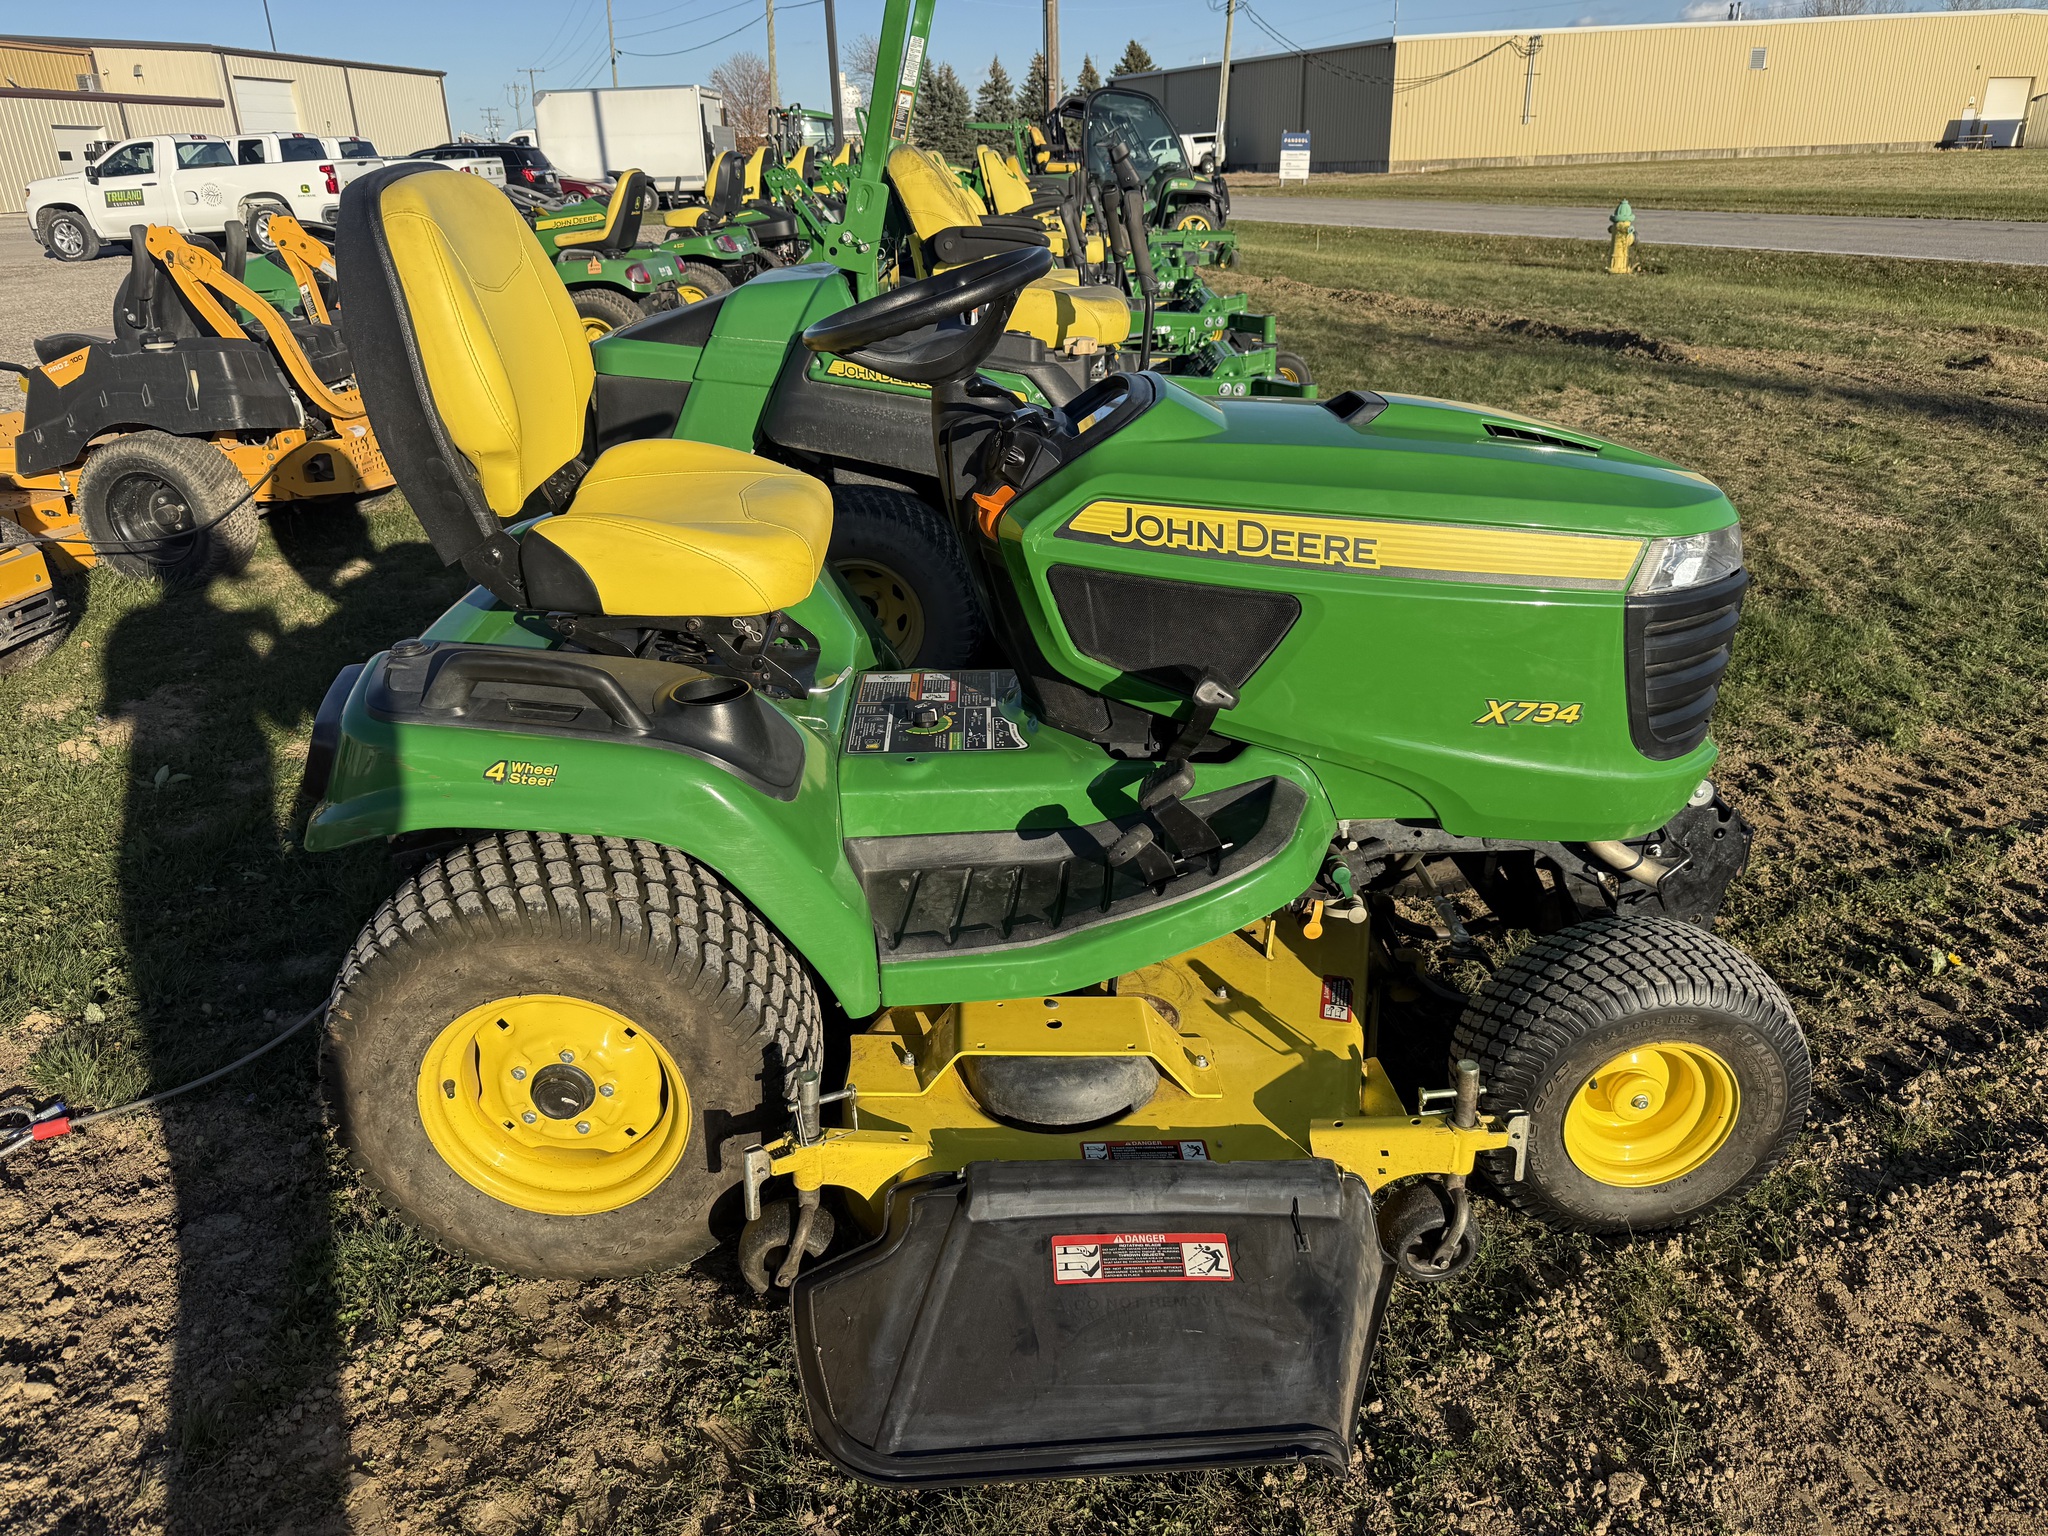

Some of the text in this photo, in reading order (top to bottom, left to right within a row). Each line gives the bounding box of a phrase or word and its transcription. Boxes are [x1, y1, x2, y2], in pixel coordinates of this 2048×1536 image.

[106, 190, 141, 202] TRULAND
[552, 215, 599, 229] JOHN DEERE
[47, 362, 64, 374] PRO
[69, 354, 84, 364] 100
[838, 363, 878, 381] JOHN
[1110, 506, 1380, 566] JOHN DEERE
[1474, 699, 1583, 726] X734
[484, 760, 559, 783] 4 Wheel
[508, 773, 555, 788] Steer
[1740, 1031, 1784, 1124] CARLISLE
[1527, 1121, 1550, 1186] TRAC
[1124, 1234, 1166, 1244] DANGER
[1150, 1295, 1223, 1309] REMOVE
